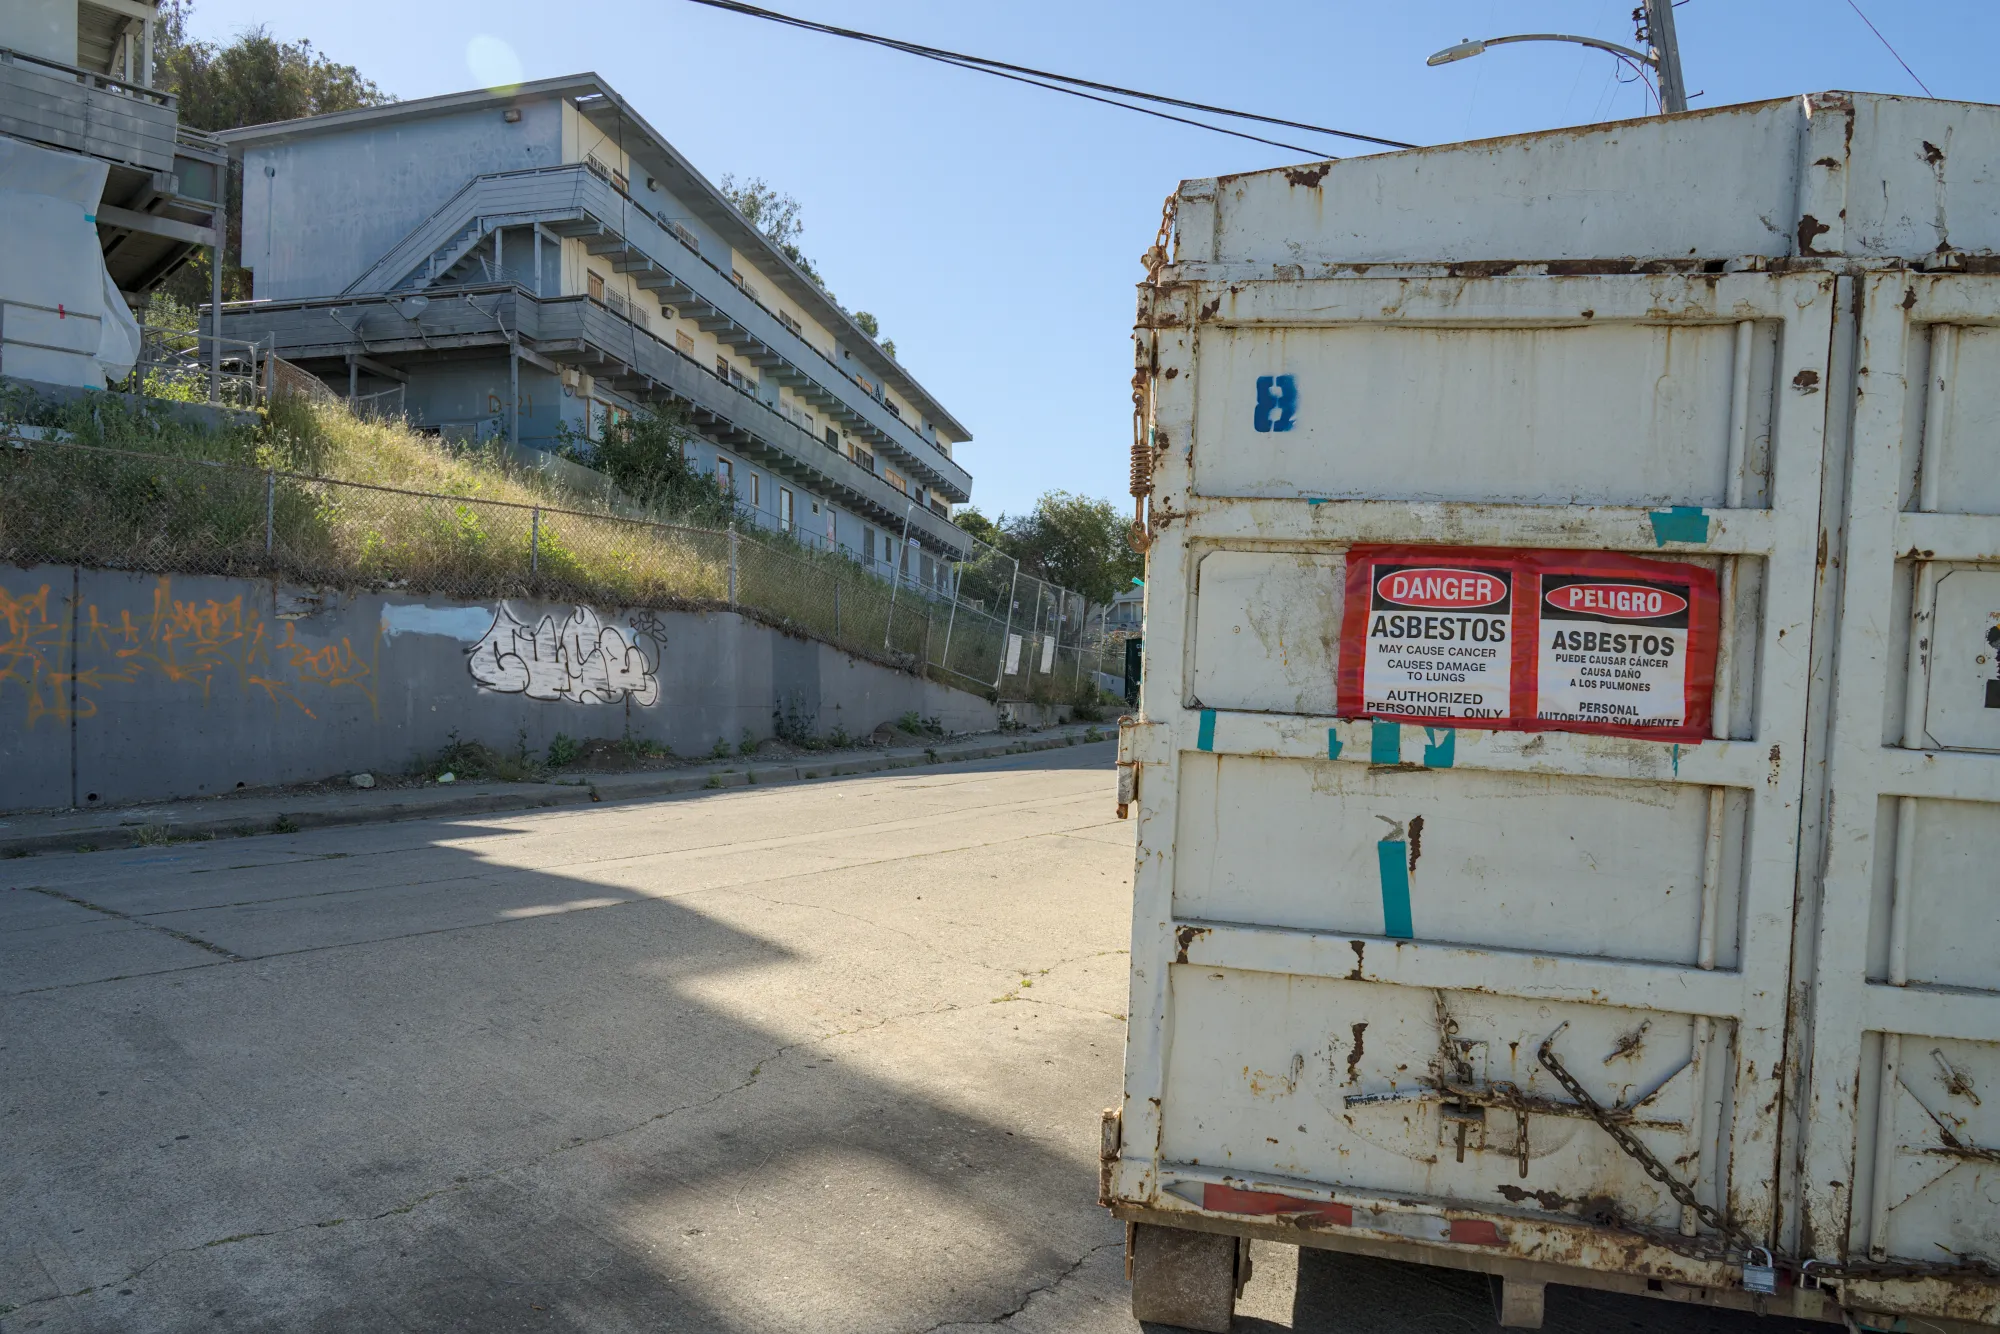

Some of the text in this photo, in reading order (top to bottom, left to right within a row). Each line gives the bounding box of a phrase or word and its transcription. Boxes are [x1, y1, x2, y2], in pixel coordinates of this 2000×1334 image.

[1254, 374, 1297, 432] 8
[1392, 577, 1492, 601] DANGER
[1569, 588, 1662, 612] PELIGRO
[1370, 615, 1506, 642] ASBESTOS
[1378, 644, 1496, 658] MAY CAUSE CANCER
[1551, 630, 1675, 657] ASBESTOS
[1387, 659, 1487, 672] CAUSES DAMAGE
[1555, 654, 1669, 668] PUEDE CAUSAR CÁNCER
[1407, 671, 1465, 682] TO LUNGS
[1580, 667, 1642, 679] CAUSA DAÑO
[1569, 678, 1651, 692] A LOS PULMONES
[1386, 690, 1483, 705] AUTHORIZED
[1366, 702, 1504, 718] PERSONNEL ONLY
[1579, 702, 1639, 716] PERSONAL
[1537, 711, 1680, 727] AUTORIZADO SOLAMENTE
